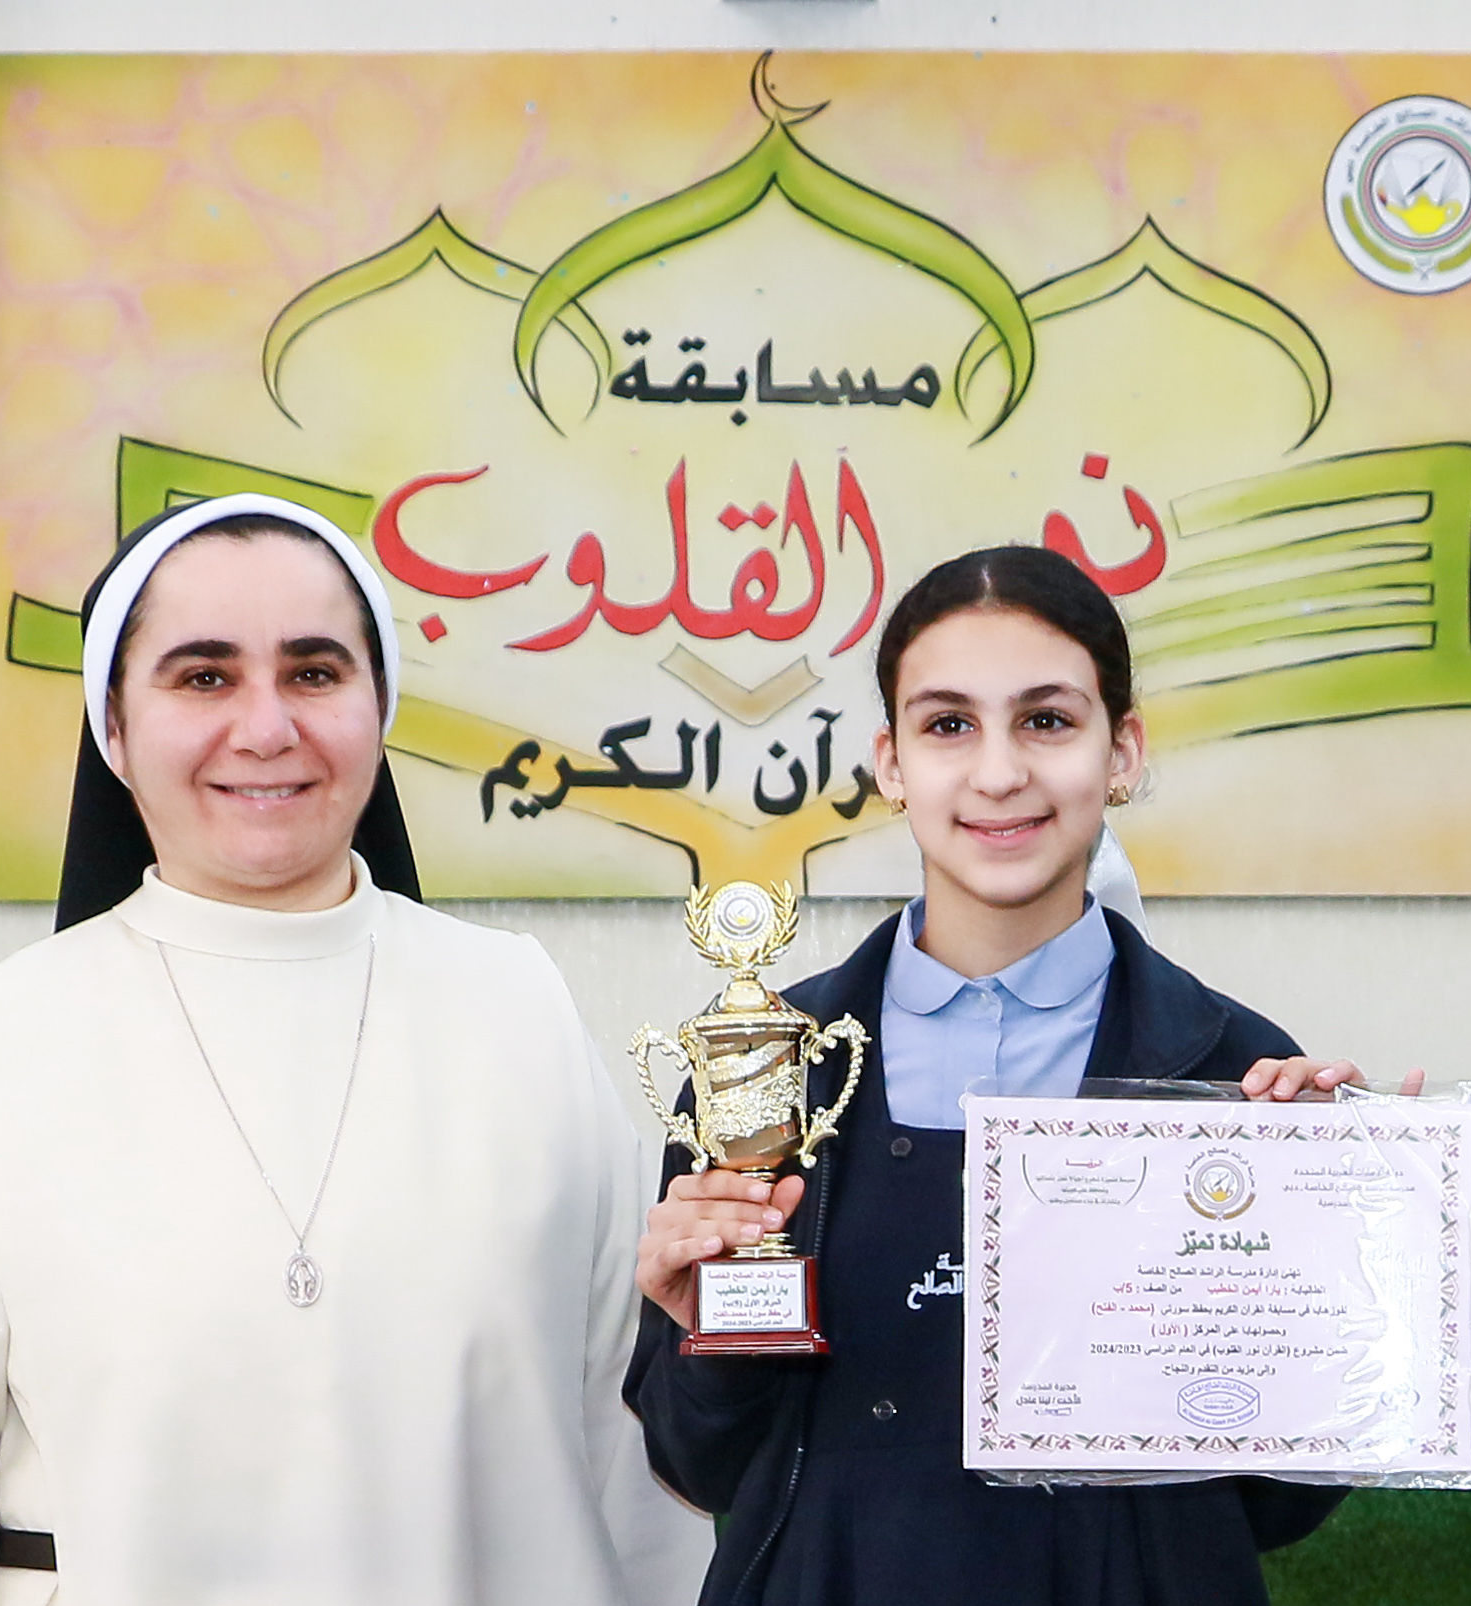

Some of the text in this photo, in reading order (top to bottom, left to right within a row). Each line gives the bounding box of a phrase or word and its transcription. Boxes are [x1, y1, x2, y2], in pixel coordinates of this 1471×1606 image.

[609, 327, 942, 426] مسابقة
[371, 451, 1168, 658] نو القلوب
[479, 715, 721, 824] الكريم
[1219, 1230, 1271, 1257] شهادة
[1137, 1264, 1166, 1275] الخاصة
[1169, 1266, 1197, 1279] الصالح
[1200, 1266, 1224, 1278] الراشد
[1227, 1265, 1257, 1278] مدرسة
[1170, 1286, 1182, 1295] من
[1207, 1282, 1239, 1295] الخطيب
[1160, 1304, 1190, 1316] سورتي
[1191, 1303, 1213, 1316] بحفظ
[1215, 1303, 1238, 1317] الكريم
[1268, 1303, 1296, 1316] مسابقة
[1298, 1304, 1310, 1317] في
[1192, 1323, 1221, 1337] المركز
[1223, 1325, 1239, 1338] على
[1143, 1344, 1176, 1357] الدراسي
[1198, 1343, 1211, 1357] في
[1246, 1344, 1260, 1356] نور
[1293, 1345, 1324, 1359] مشروع
[1197, 1363, 1220, 1376] التقدم
[1221, 1364, 1234, 1375] من
[1236, 1364, 1255, 1376] مزيد
